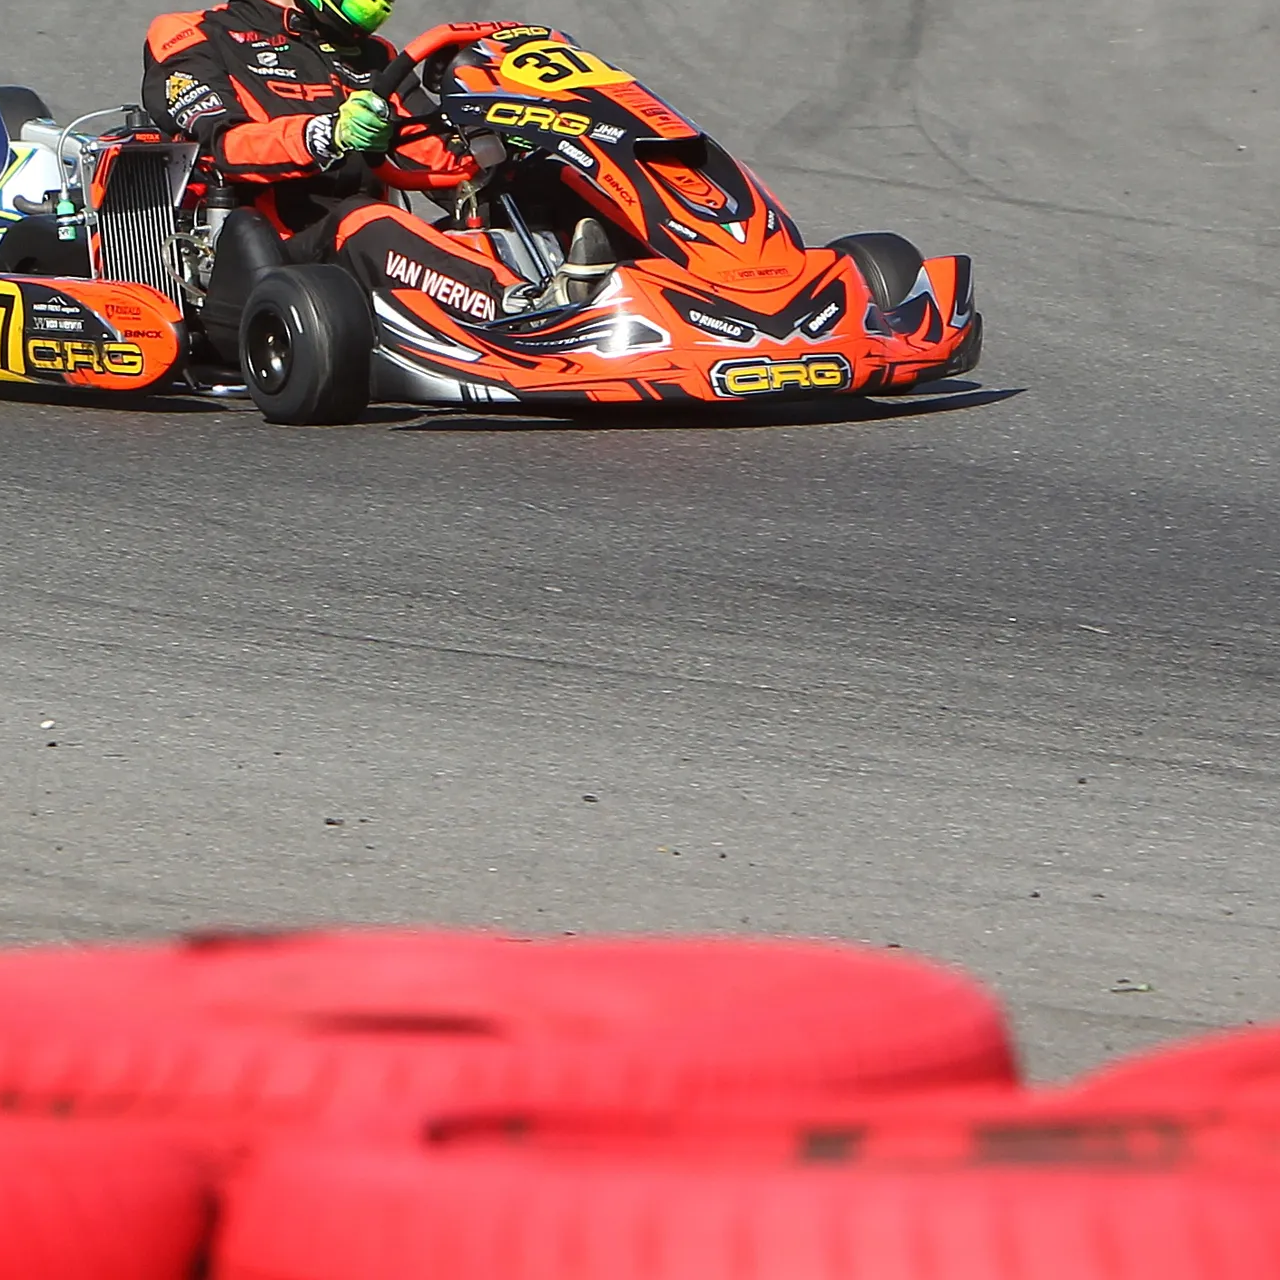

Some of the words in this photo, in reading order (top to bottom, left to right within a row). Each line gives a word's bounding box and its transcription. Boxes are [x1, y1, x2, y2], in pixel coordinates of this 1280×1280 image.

[492, 27, 549, 40] CRG
[513, 47, 610, 83] 37
[179, 95, 221, 125] JHM
[486, 102, 591, 136] CRG
[593, 123, 626, 139] JHM
[603, 174, 636, 207] BINCX
[386, 250, 422, 287] VAN
[421, 267, 496, 320] WERVEN
[124, 330, 163, 339] BINCX
[700, 312, 745, 337] RIWALD
[28, 338, 144, 376] CRG
[725, 361, 842, 392] CRG
